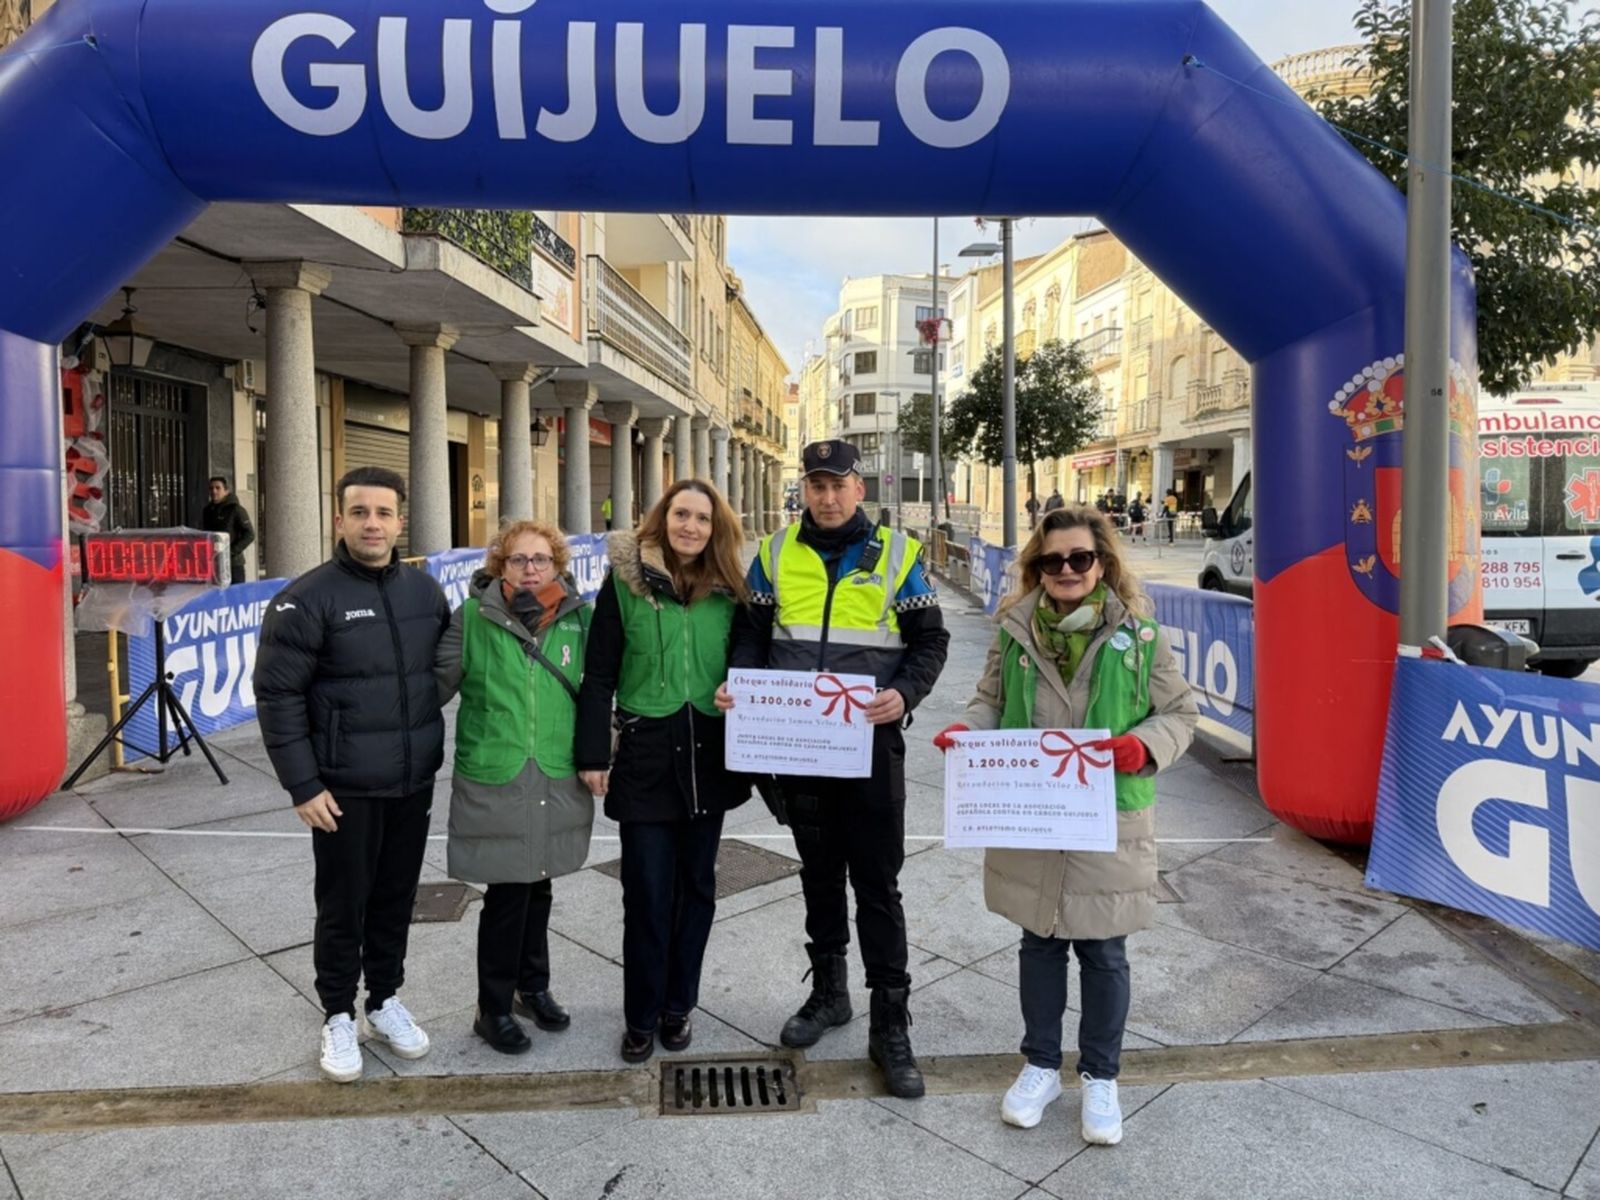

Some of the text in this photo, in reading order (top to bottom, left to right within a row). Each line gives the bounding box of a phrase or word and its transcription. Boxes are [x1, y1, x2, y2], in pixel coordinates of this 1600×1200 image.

[1476, 436, 1600, 457] sistenci
[1481, 562, 1540, 574] 288 795
[1481, 577, 1541, 588] 810 954
[734, 676, 813, 688] Cheque solidario
[750, 695, 812, 707] 1.200,00€
[953, 738, 1039, 750] heque solidario
[968, 758, 1039, 769] 1.200,00€
